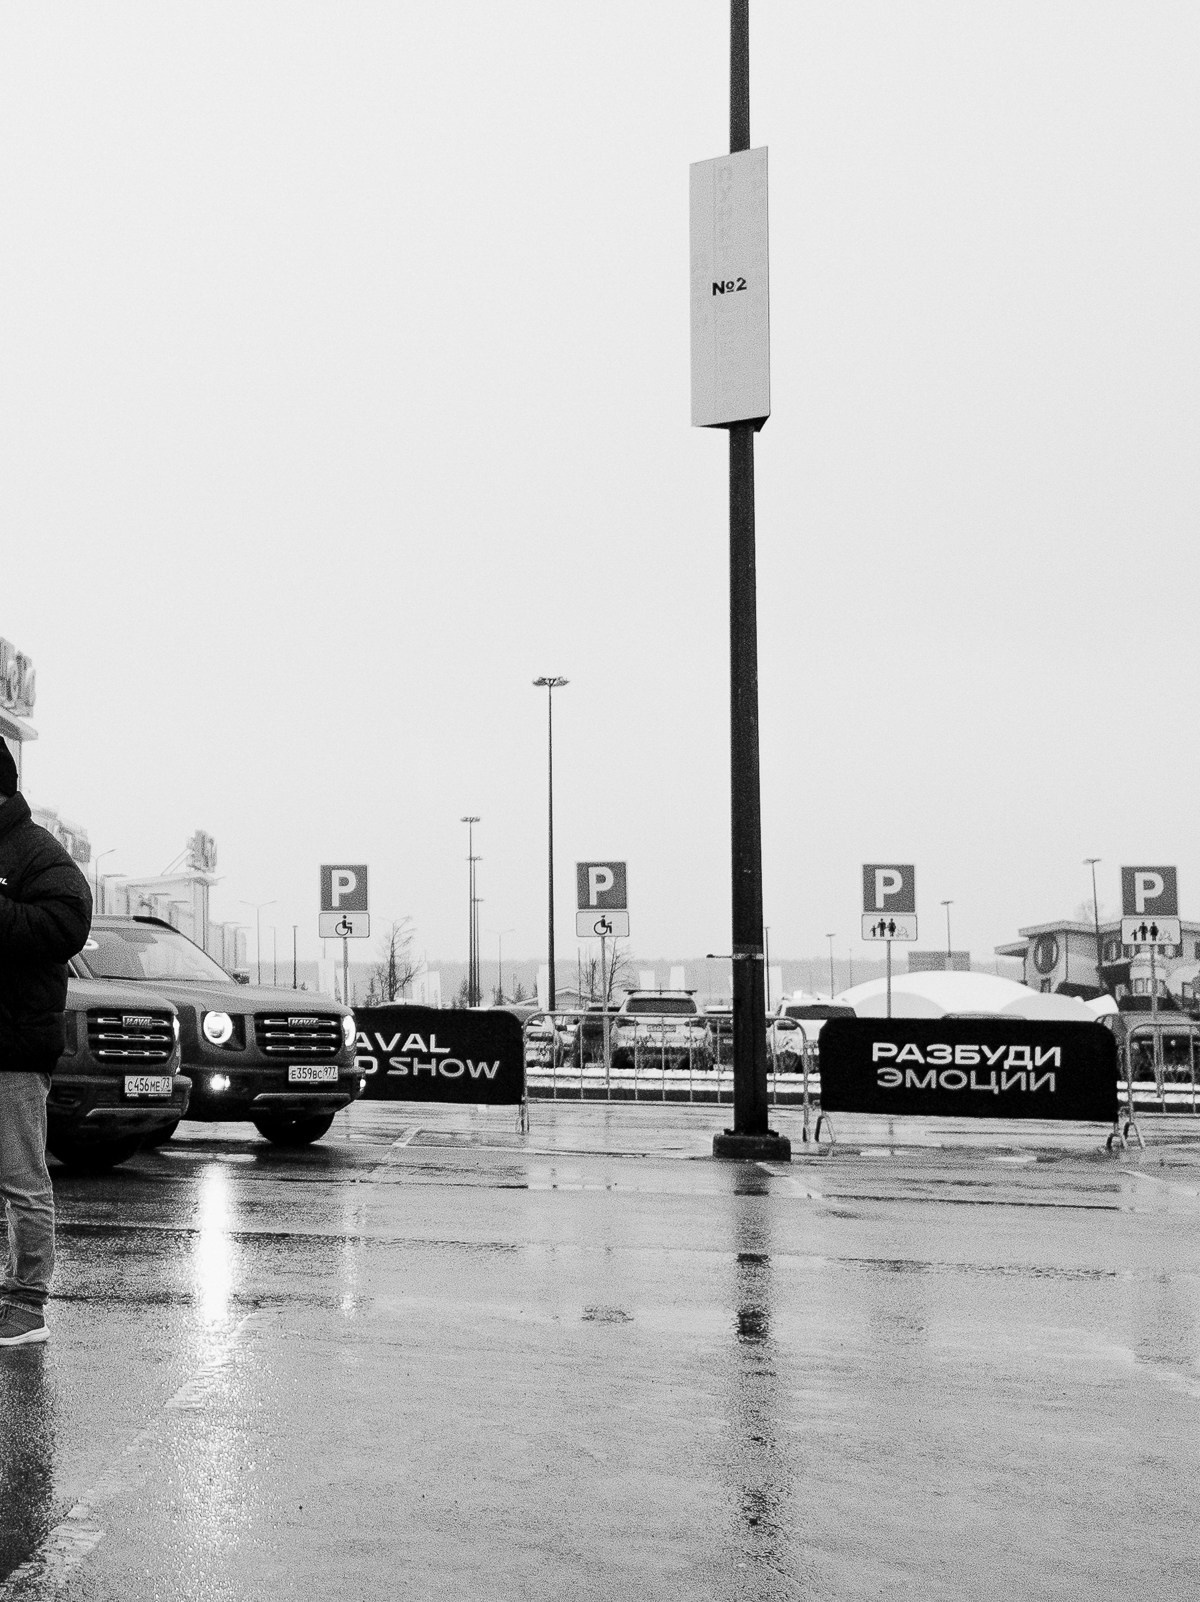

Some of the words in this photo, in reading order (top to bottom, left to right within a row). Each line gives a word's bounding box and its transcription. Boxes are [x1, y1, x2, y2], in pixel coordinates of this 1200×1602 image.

[712, 276, 747, 296] №2
[331, 869, 357, 907] P
[588, 866, 614, 906] P
[875, 868, 903, 909] P
[1135, 871, 1164, 913] P
[125, 1018, 152, 1026] HAVAL
[355, 1031, 451, 1053] AVAL
[386, 1057, 501, 1079] SHOW
[872, 1042, 1061, 1070] РАЗБУДИ
[877, 1067, 1056, 1094] ЭМОЦИИ
